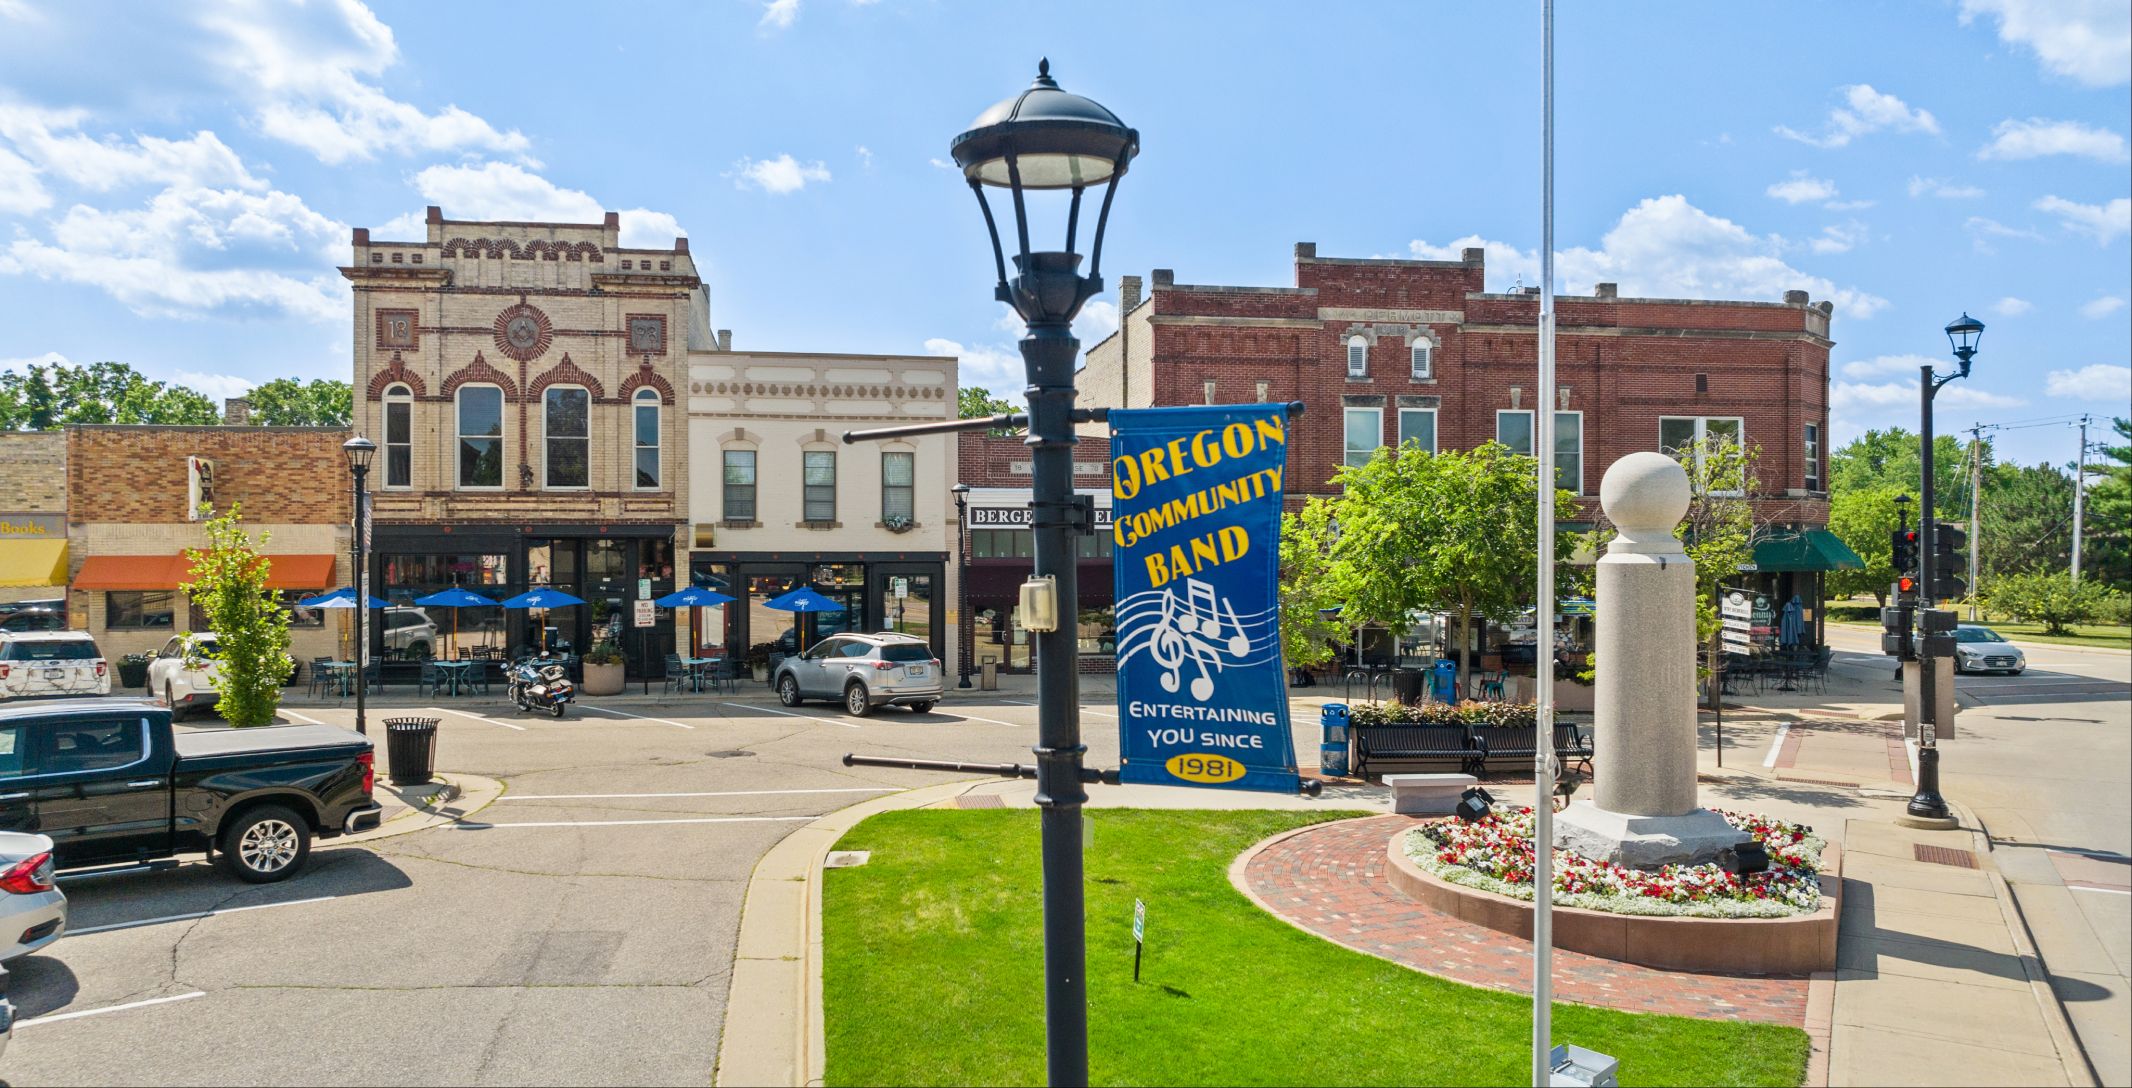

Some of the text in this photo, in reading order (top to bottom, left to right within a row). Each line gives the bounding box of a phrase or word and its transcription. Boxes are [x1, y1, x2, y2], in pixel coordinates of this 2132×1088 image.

[388, 320, 407, 338] 18
[1113, 415, 1285, 499] OREGON
[1114, 465, 1283, 547] COMMUNITY
[1, 521, 46, 534] Books
[1144, 526, 1249, 588] BAND
[1129, 701, 1276, 726] ENTERTAINING
[1147, 728, 1263, 748] YOU SINCE
[1178, 758, 1232, 777] 1981
